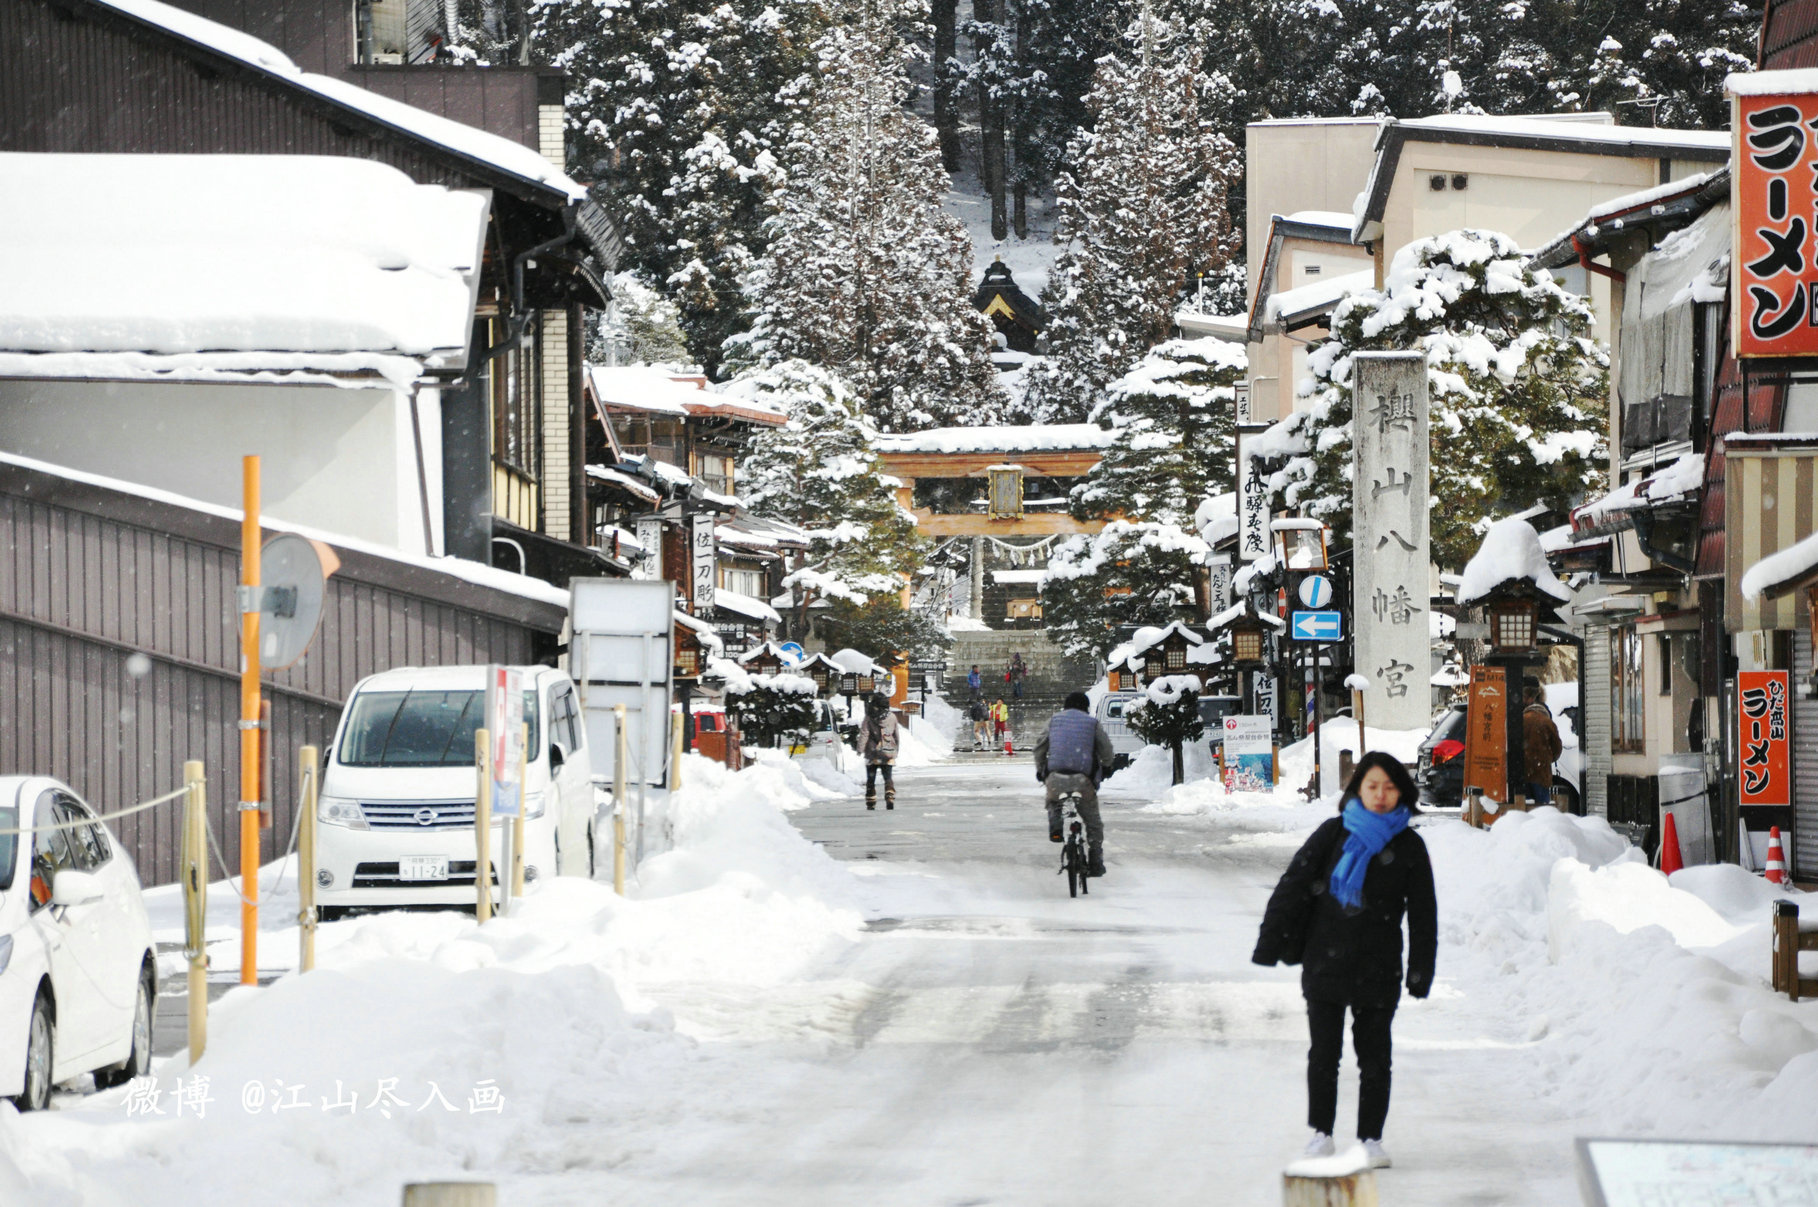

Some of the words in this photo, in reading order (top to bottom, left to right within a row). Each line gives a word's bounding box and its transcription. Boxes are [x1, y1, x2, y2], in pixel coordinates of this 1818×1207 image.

[1745, 104, 1807, 341] ラーメン
[1367, 393, 1422, 699] 櫻山八幡宮
[1742, 688, 1770, 795] ラーメン
